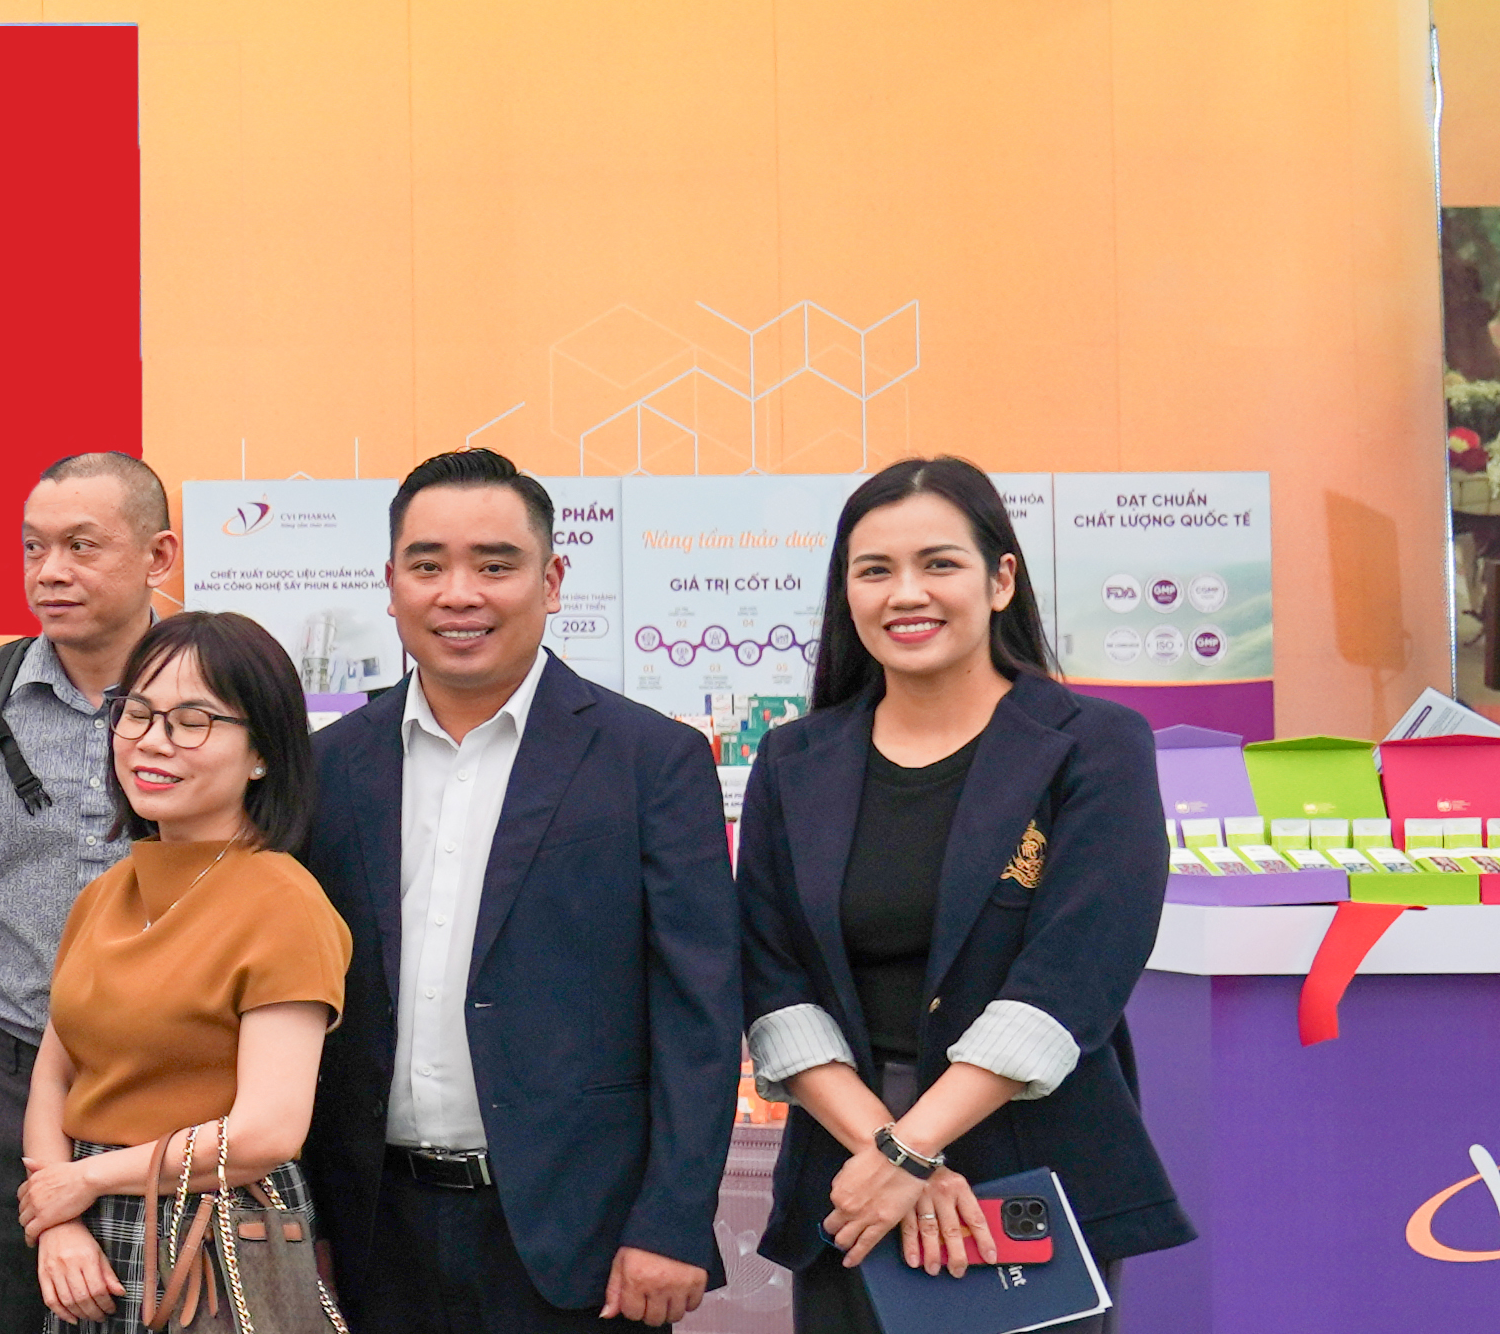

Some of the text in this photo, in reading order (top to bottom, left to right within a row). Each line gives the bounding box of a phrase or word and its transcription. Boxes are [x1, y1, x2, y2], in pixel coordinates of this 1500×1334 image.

[1116, 488, 1207, 511] ĐẠT CHUẨN
[562, 500, 614, 522] PHẨM
[1074, 509, 1116, 528] CHẤT
[1180, 509, 1229, 528] QUỐC
[553, 531, 594, 546] CAO
[670, 574, 700, 592] GIÁ
[734, 572, 770, 592] CỐT
[562, 620, 596, 633] 2023
